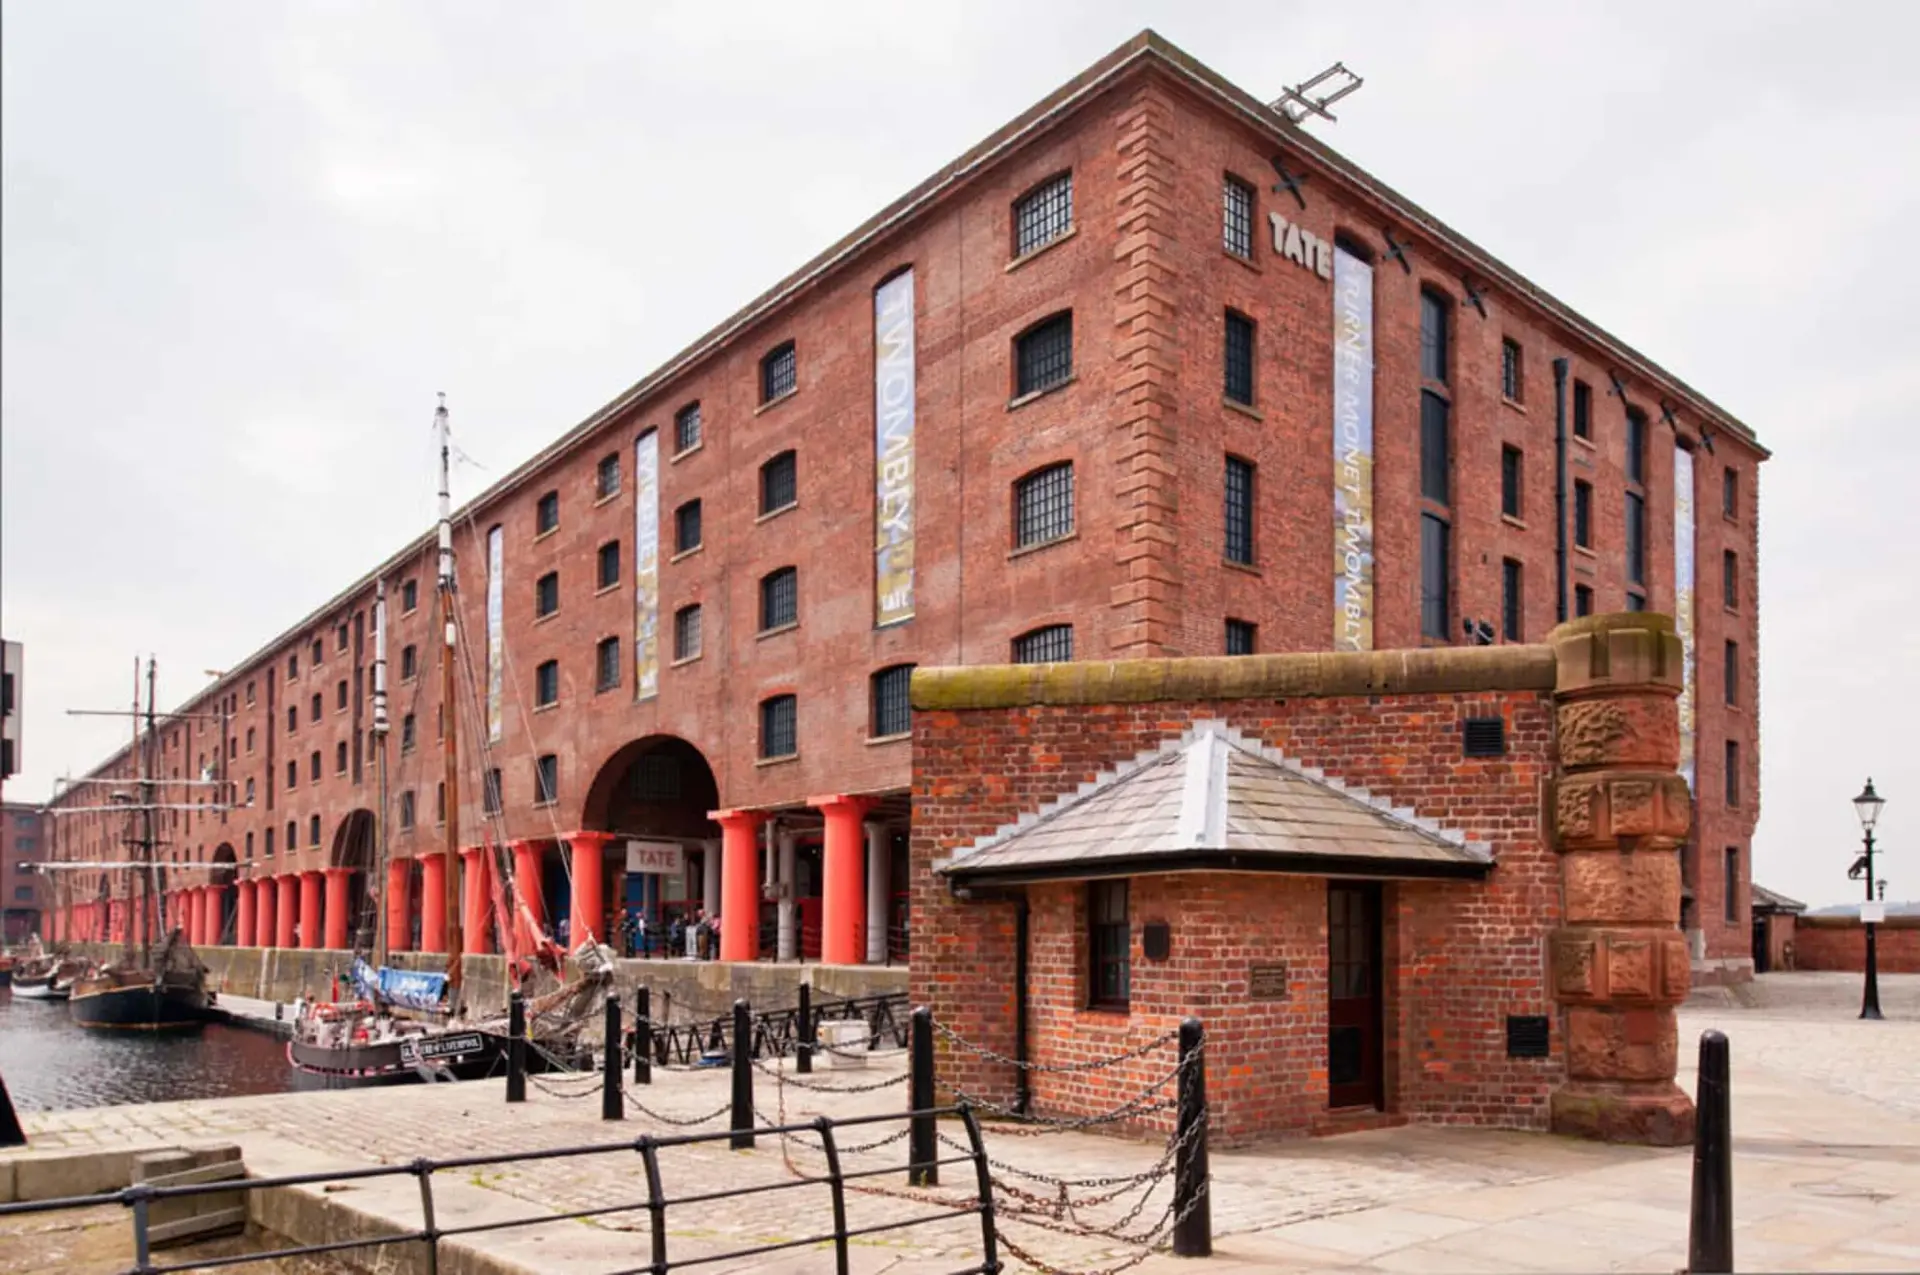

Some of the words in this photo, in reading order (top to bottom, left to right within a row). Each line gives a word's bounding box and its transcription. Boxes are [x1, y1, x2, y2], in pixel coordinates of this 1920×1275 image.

[1268, 211, 1332, 280] TATE
[1344, 274, 1361, 386] TURNER
[882, 287, 909, 531] TWOMBLY
[1343, 391, 1361, 499] MONET
[1344, 507, 1362, 651] TWOMBLY
[638, 849, 676, 868] TATE
